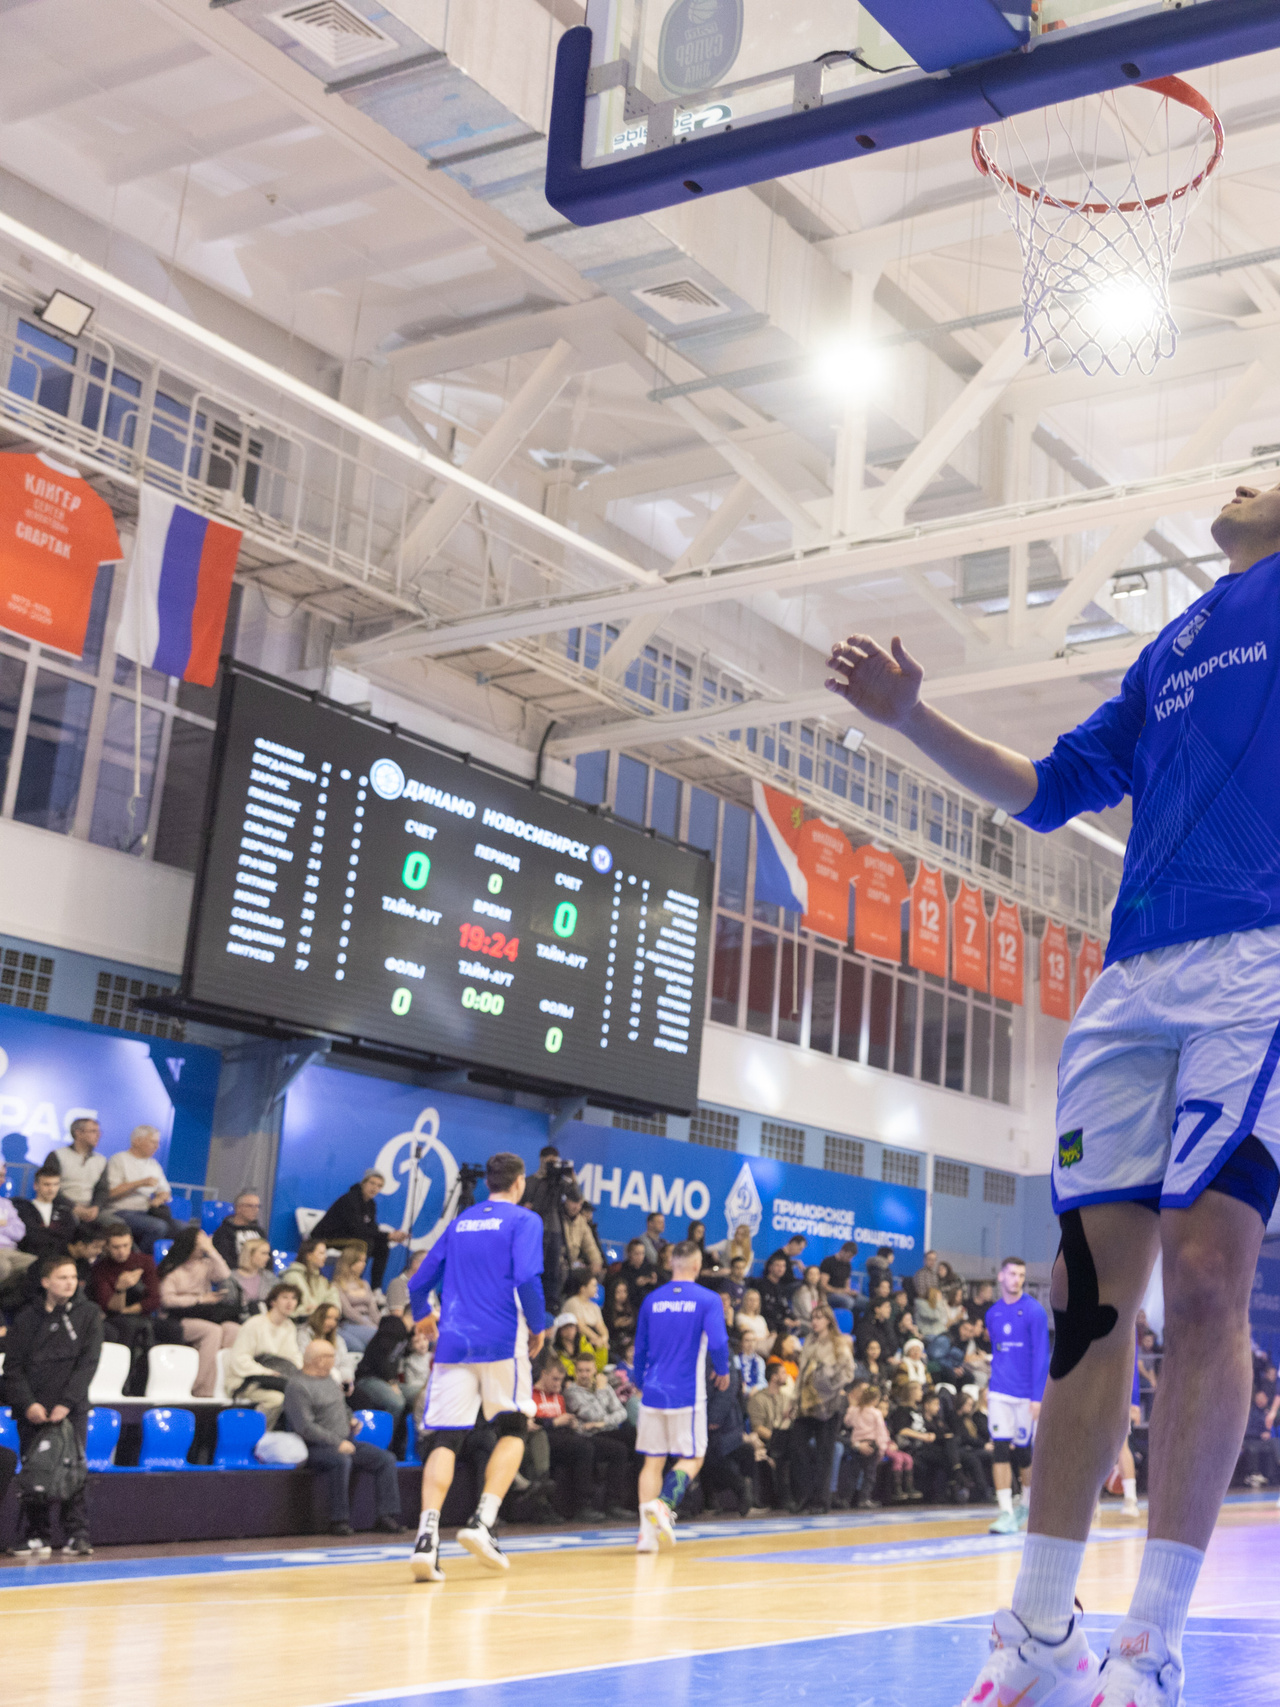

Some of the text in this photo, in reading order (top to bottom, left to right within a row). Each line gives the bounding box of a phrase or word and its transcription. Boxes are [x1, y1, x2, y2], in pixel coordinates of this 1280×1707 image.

[25, 472, 82, 512] КЛИГЕР
[15, 521, 71, 560] СПАРТАК
[1158, 641, 1268, 697] ИМОРСКИЙ
[1154, 686, 1195, 722] КРАЙ
[252, 751, 317, 784] БОГДАНОВИЧ
[402, 779, 591, 862] ДИНАМО НОВОСИБИРСК
[404, 818, 438, 841] СЧЕТ
[402, 850, 431, 891] 0
[473, 843, 521, 873] ПЕРИОД
[487, 873, 503, 895] 0
[554, 872, 584, 892] СЧЕТ
[472, 898, 513, 923] ВРЕМЯ
[552, 900, 578, 938] 0
[919, 898, 940, 932] 12
[458, 922, 520, 963] 19:24
[964, 915, 978, 944] 7
[997, 931, 1018, 963] 12
[383, 956, 426, 981] ФОЛЫ
[1048, 953, 1066, 980] 13
[390, 987, 413, 1016] 0
[460, 986, 505, 1016] 0:00
[538, 998, 575, 1020] ФОЛЫ
[544, 1026, 564, 1054] 0
[575, 1162, 711, 1221] ИНАМО
[456, 1217, 503, 1233] СЕМЕНЮК
[773, 1198, 856, 1226] ПРИМОРСКОЕ
[772, 1215, 915, 1250] СПОРТИВНОЕ ОБЩЕСТВО
[652, 1300, 697, 1313] КОРЧАГИН
